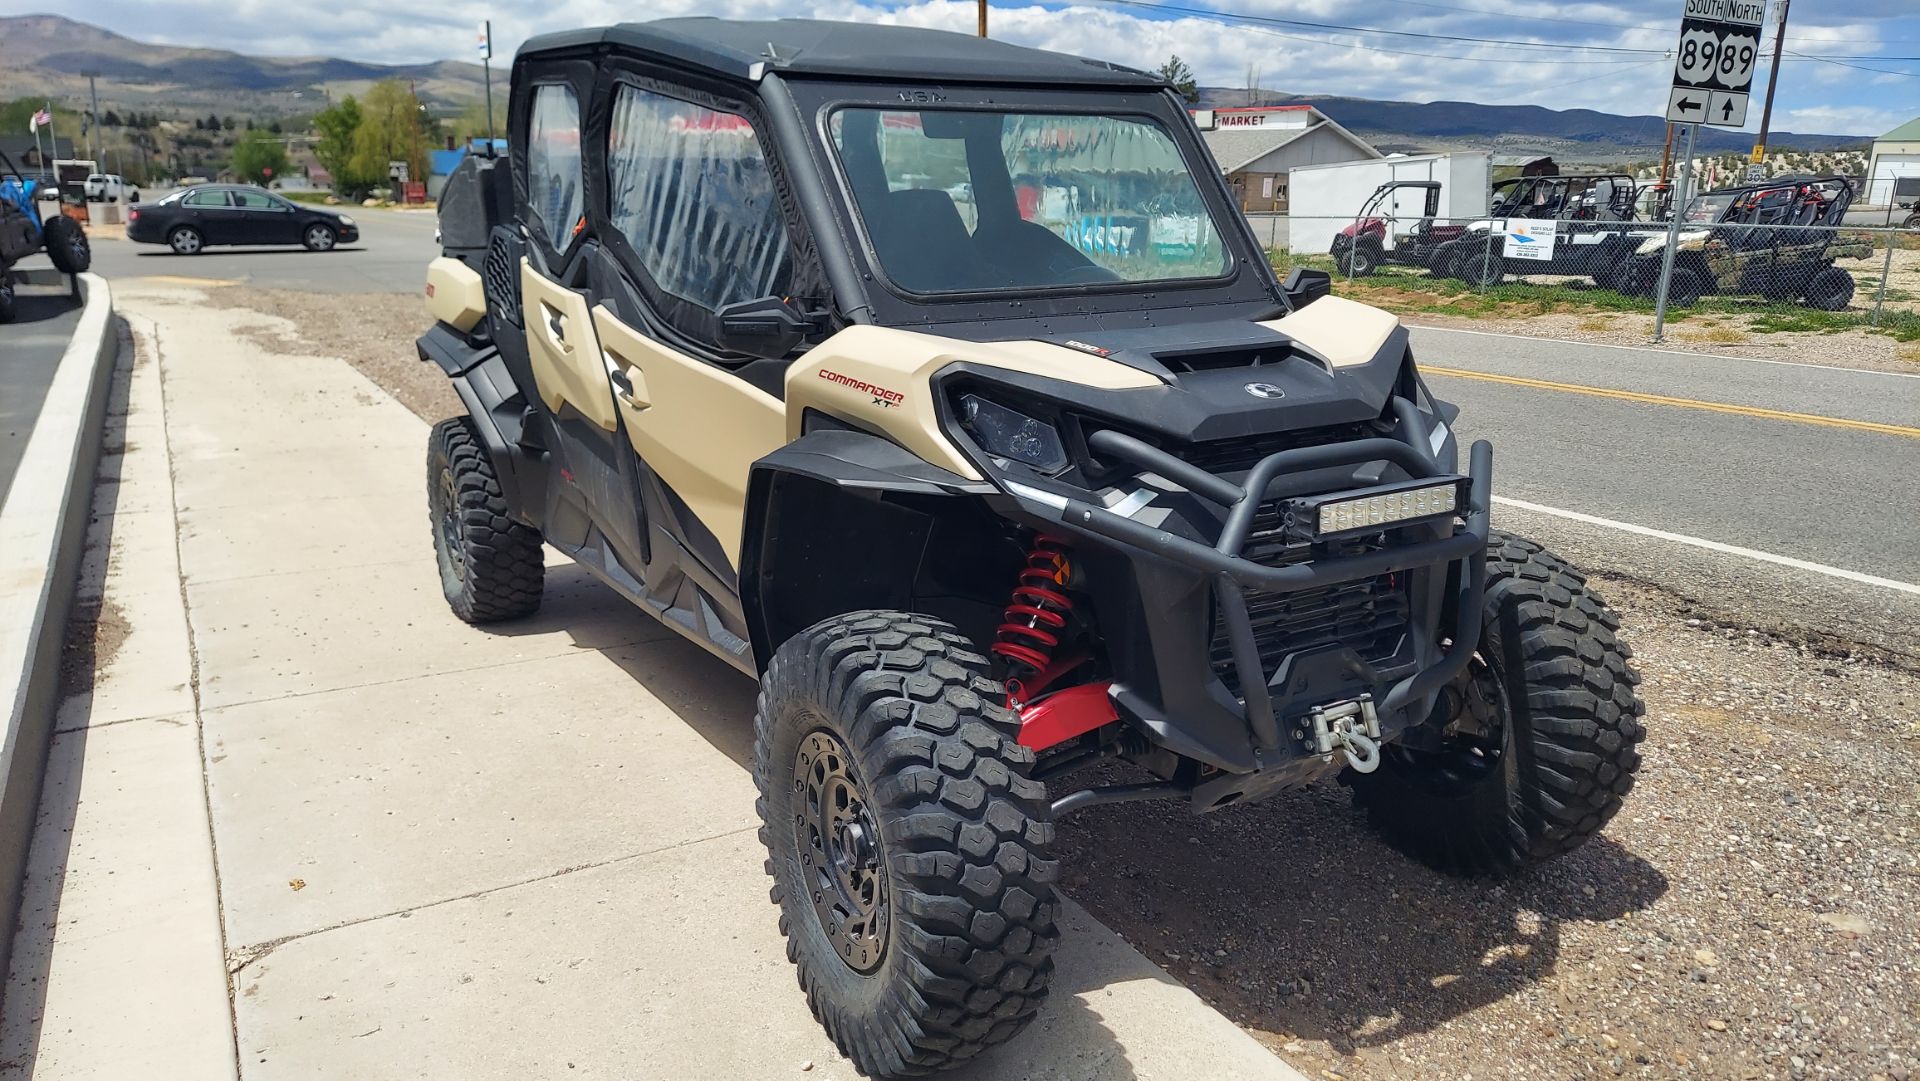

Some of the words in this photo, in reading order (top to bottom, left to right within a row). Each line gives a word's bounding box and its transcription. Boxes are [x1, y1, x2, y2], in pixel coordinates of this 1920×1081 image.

[1688, 0, 1723, 17] SOUTH
[1727, 0, 1763, 22] NORTH
[1682, 39, 1715, 71] 89
[1720, 45, 1753, 75] 89
[1221, 115, 1266, 126] MARKET
[1747, 173, 1761, 182] 30
[818, 369, 905, 403] COMMANDER
